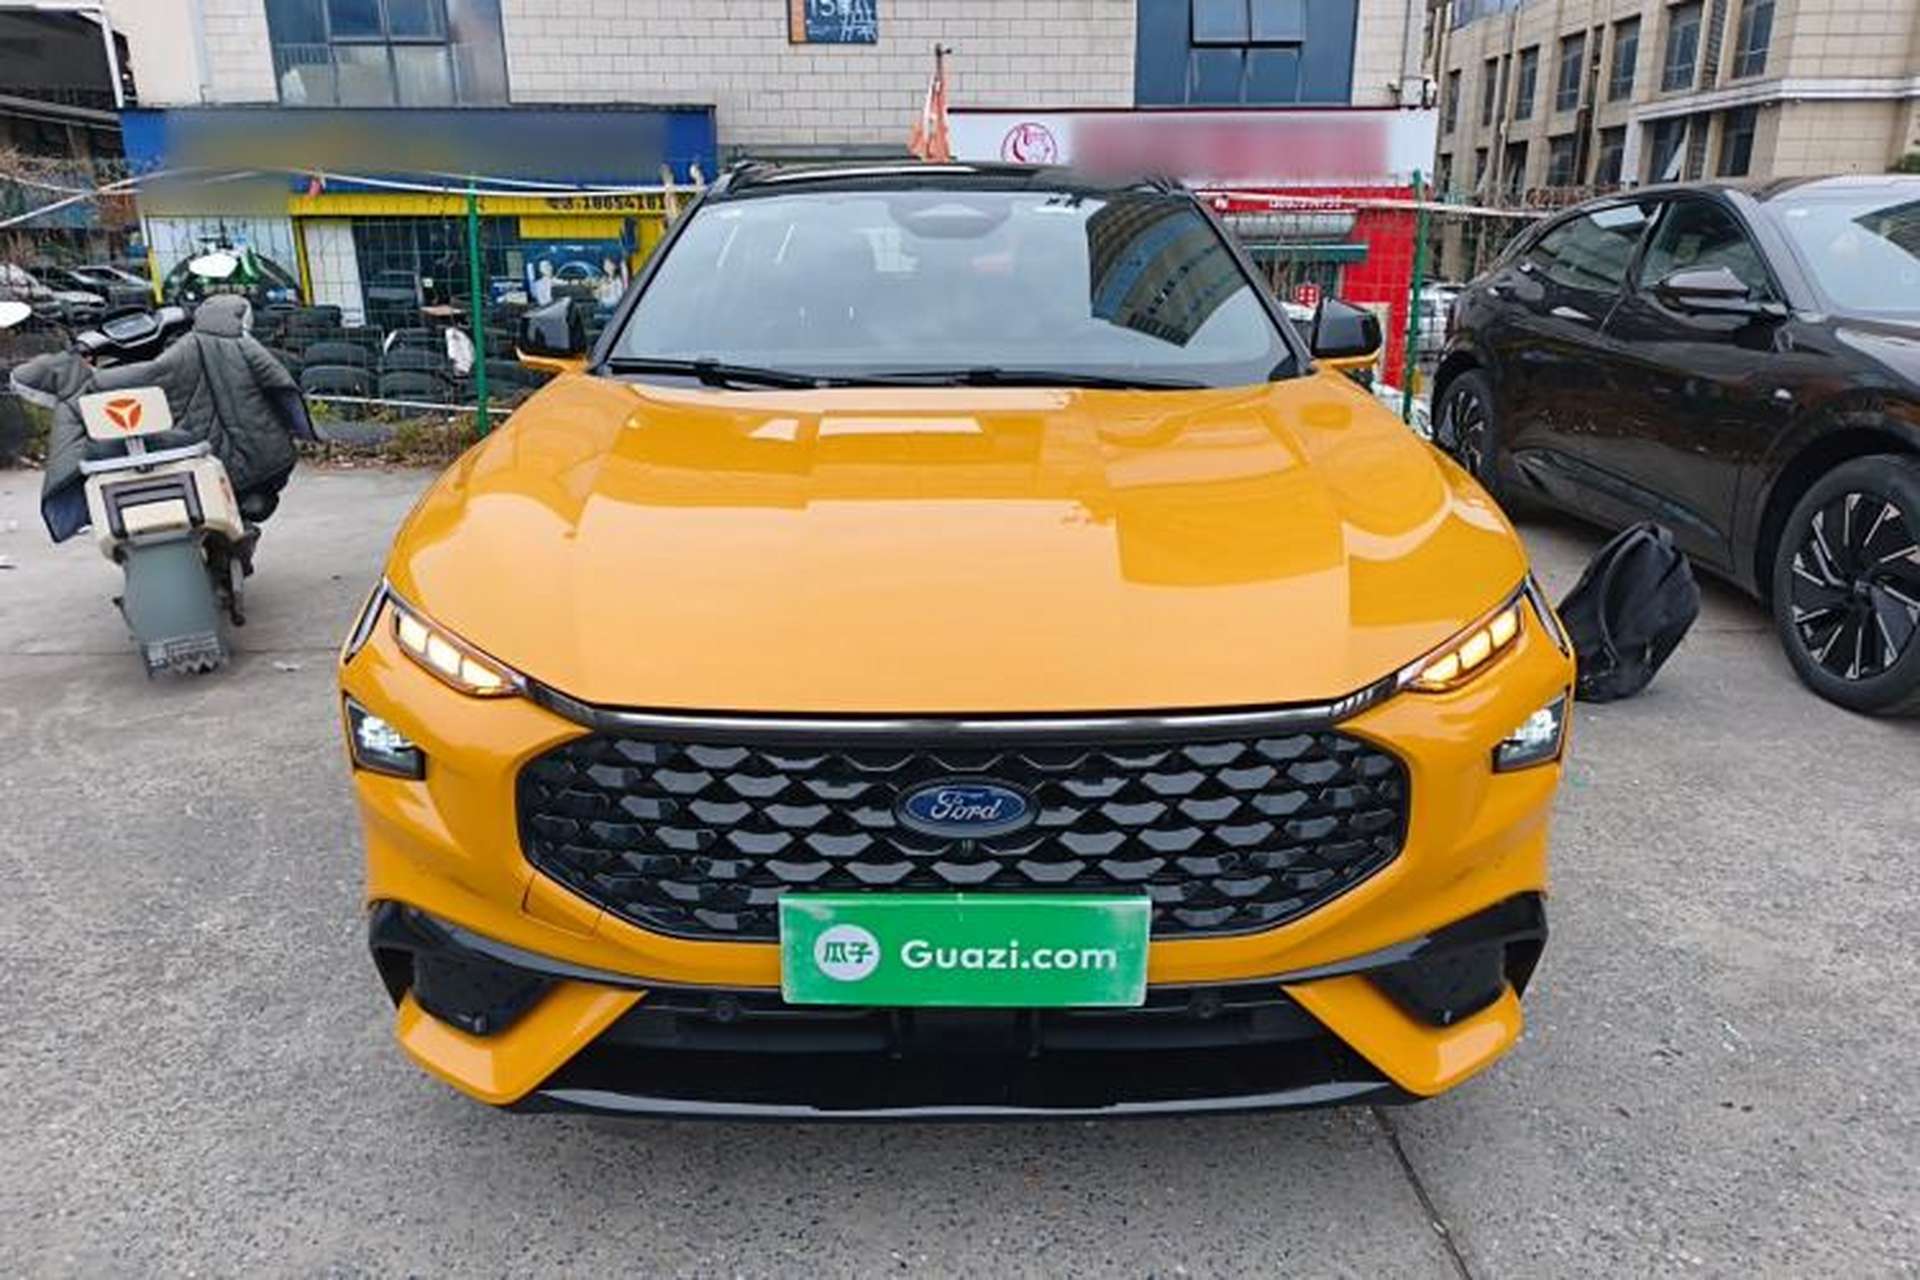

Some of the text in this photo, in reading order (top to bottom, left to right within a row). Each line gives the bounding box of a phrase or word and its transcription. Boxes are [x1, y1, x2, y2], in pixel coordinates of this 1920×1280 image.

[930, 789, 1002, 820] Ford
[824, 942, 872, 964] 瓜子
[901, 939, 1117, 970] Guazi.com
